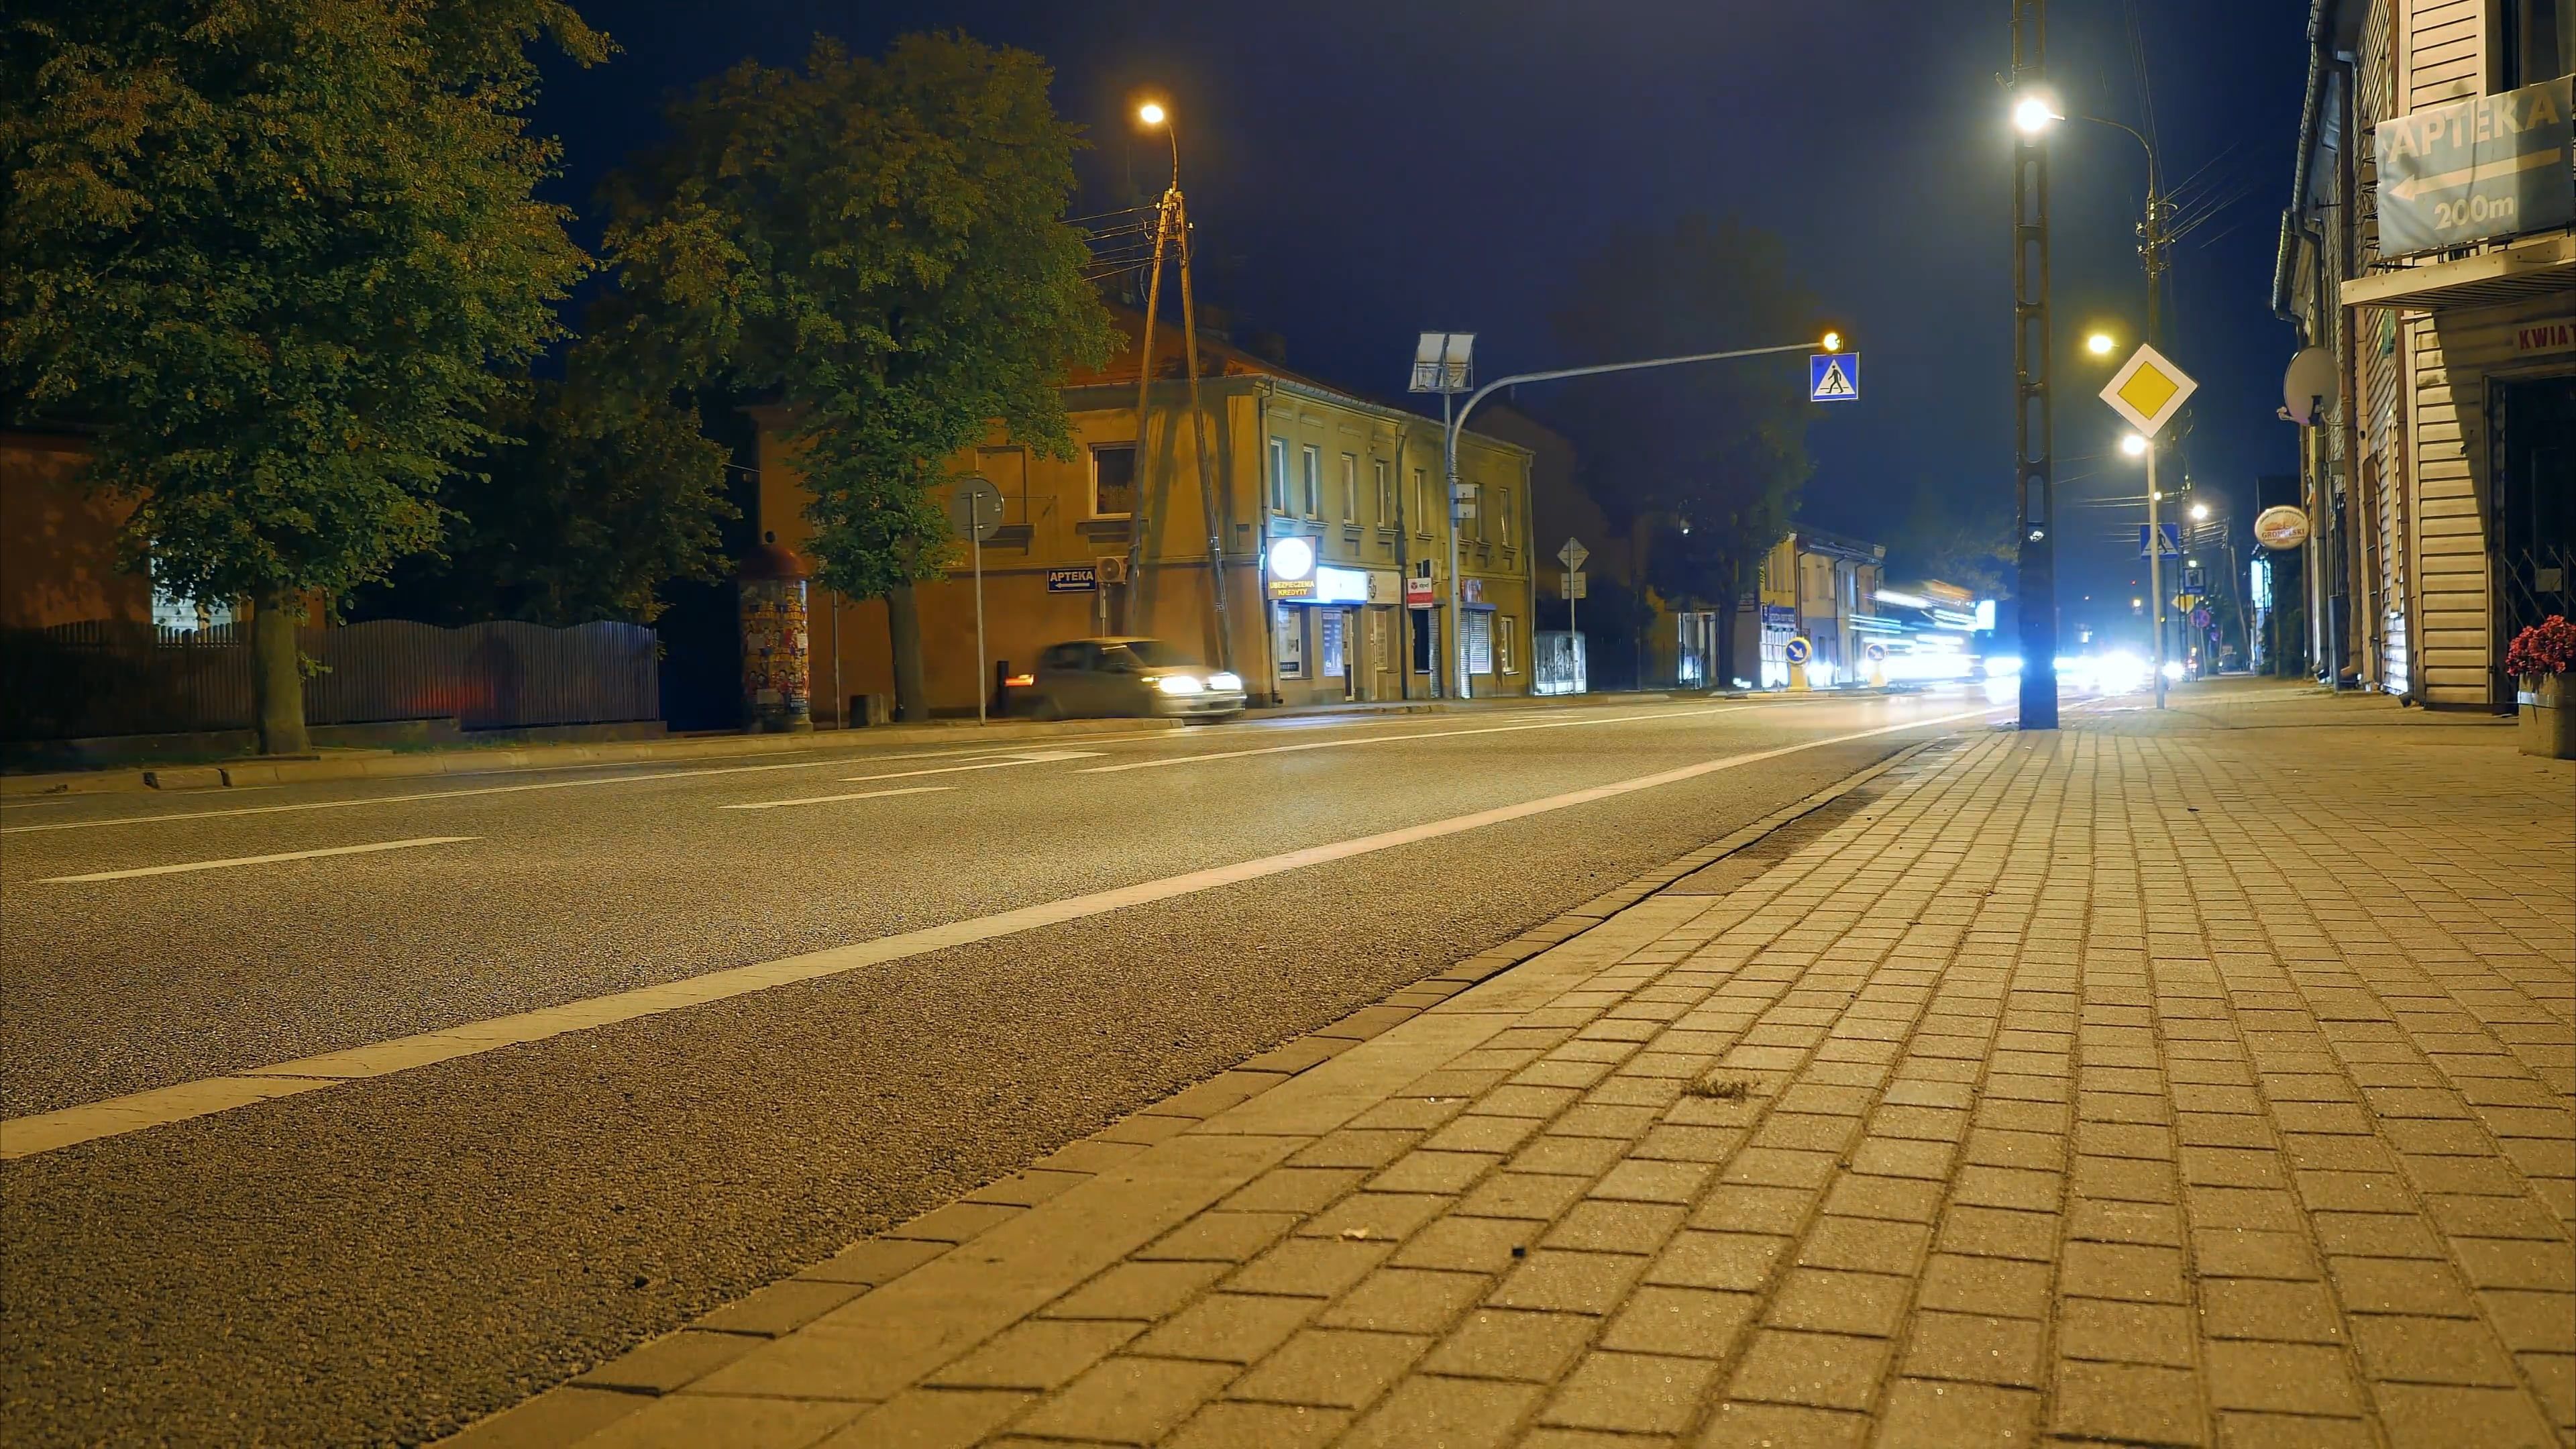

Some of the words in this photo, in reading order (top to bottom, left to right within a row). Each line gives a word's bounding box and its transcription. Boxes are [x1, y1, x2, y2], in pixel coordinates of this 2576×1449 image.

[2387, 93, 2560, 164] APTEKA
[2434, 194, 2514, 231] 200m
[2261, 529, 2305, 539] GROMLSKI
[1050, 571, 1094, 582] APTEKA
[1269, 580, 1315, 589] UBEZPIECZENIA
